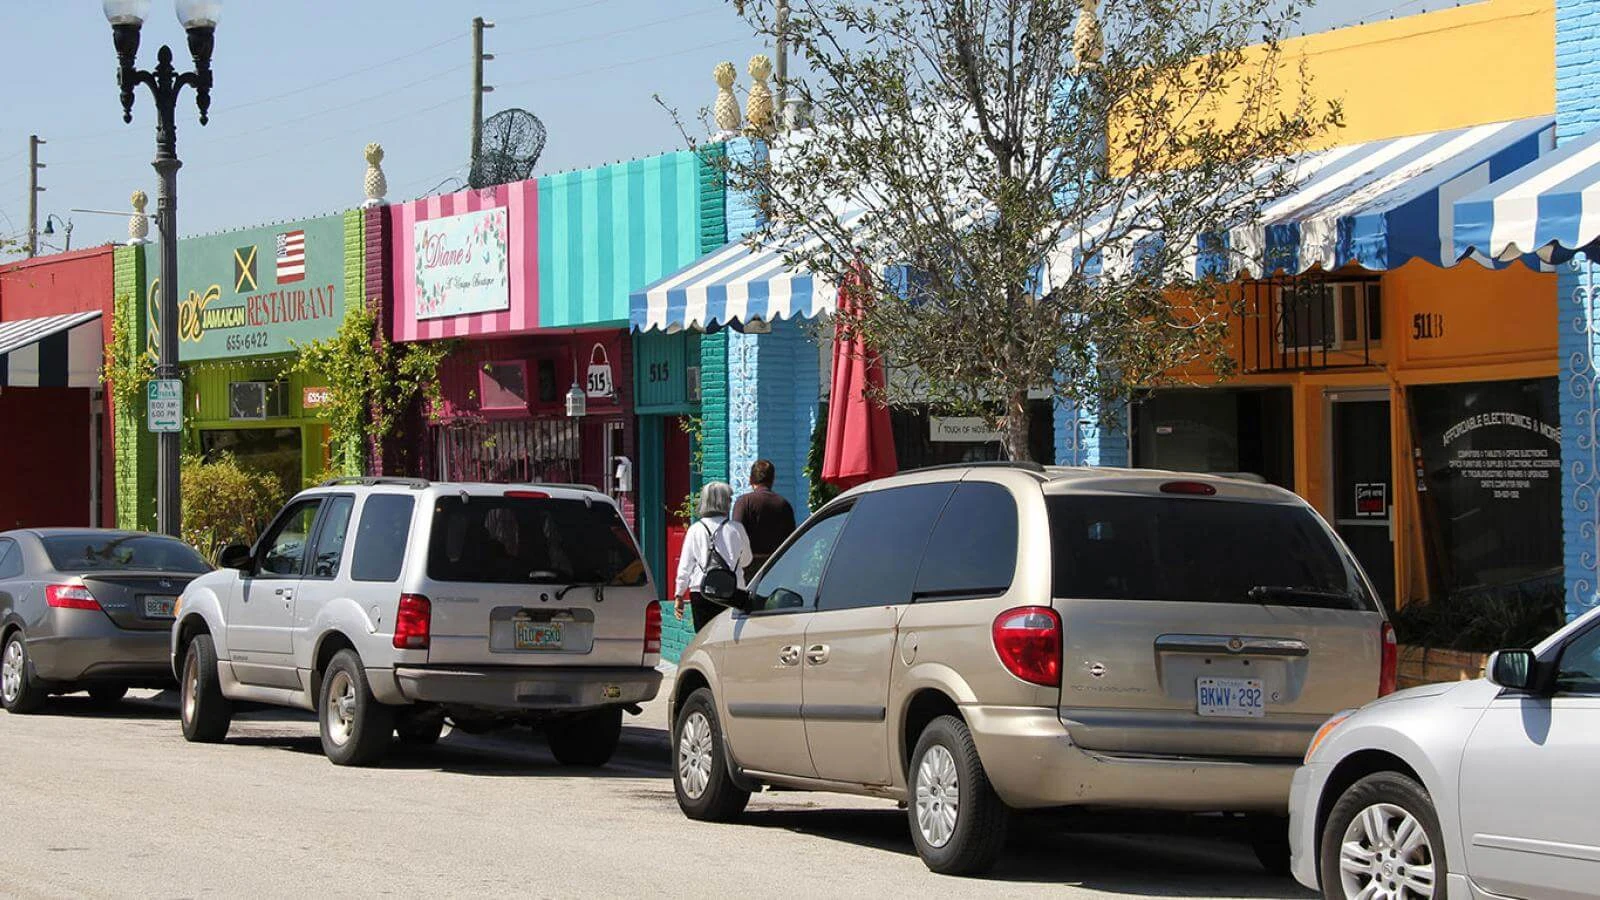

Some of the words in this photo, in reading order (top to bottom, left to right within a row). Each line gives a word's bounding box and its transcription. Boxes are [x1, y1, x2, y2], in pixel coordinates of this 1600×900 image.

[424, 232, 472, 269] Diane's
[203, 308, 245, 329] JAMAICAN
[247, 285, 335, 327] RESTAURANT
[1413, 312, 1433, 340] 511
[226, 332, 268, 350] 655-6422
[649, 360, 669, 382] 515
[150, 383, 158, 398] 2
[1443, 413, 1483, 447] AFFORDABLE
[1483, 412, 1532, 431] ELECTRONICS
[1540, 421, 1562, 445] MORE
[1200, 686, 1231, 707] BKWV
[1238, 687, 1262, 708] 292
